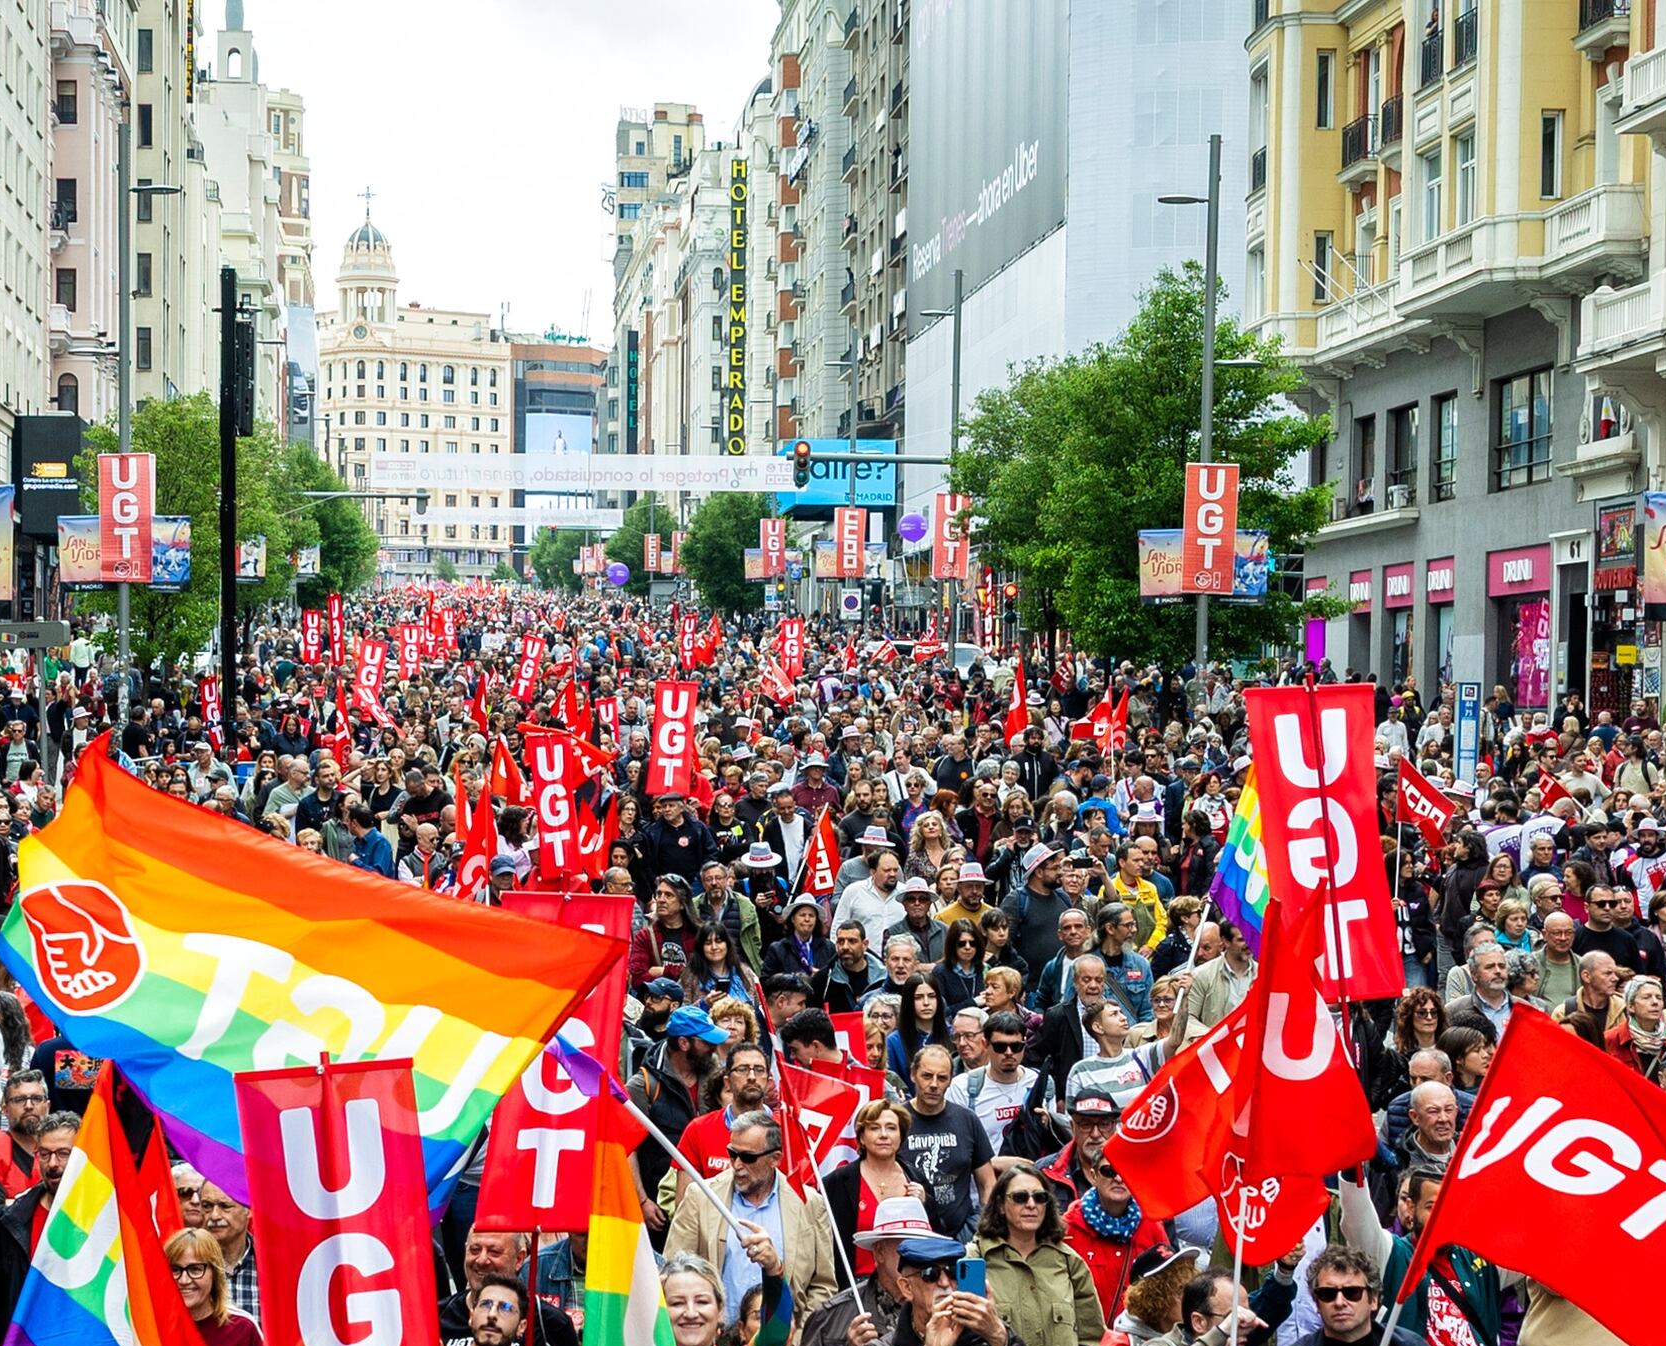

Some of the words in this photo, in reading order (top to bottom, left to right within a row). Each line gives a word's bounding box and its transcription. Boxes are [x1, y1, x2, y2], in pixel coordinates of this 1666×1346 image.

[731, 160, 747, 270] HOTEL
[912, 233, 941, 281] Reserva
[1014, 140, 1039, 191] Uber
[628, 350, 637, 428] HOTEL
[729, 284, 746, 455] EMPERADO
[112, 457, 139, 560] UGT
[856, 493, 892, 501] MADRID
[1196, 468, 1224, 568] UGT
[62, 535, 86, 550] SAN
[768, 521, 780, 567] UGT
[843, 510, 858, 569] CCOO
[1144, 548, 1167, 565] SAN
[1569, 540, 1581, 559] 61
[1152, 562, 1182, 576] ISIDR
[307, 611, 319, 658] UGT
[404, 628, 418, 678] UGT
[444, 609, 454, 646] UGT
[684, 618, 695, 664] UGT
[359, 645, 382, 687] UG
[517, 640, 540, 696] UGT
[657, 690, 689, 787] UGT
[536, 744, 571, 867] UGT
[517, 1018, 605, 1209] GT
